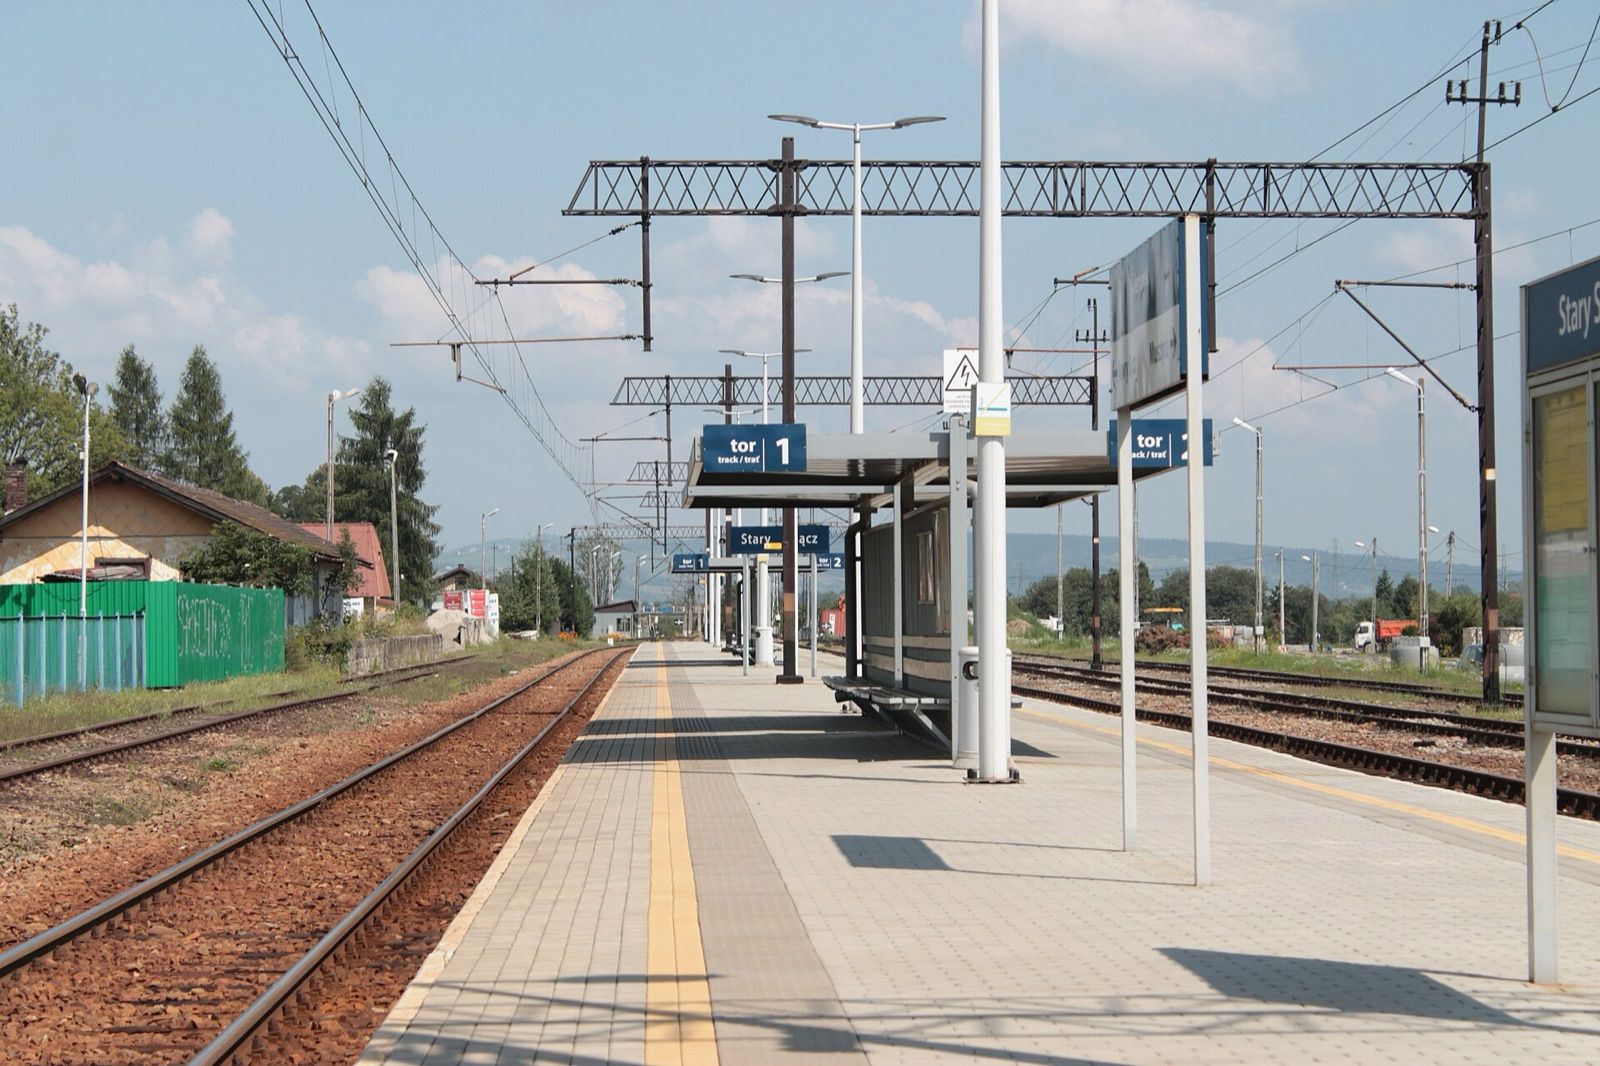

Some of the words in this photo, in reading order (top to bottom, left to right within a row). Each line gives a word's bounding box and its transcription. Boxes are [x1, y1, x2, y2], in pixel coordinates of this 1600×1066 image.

[1559, 294, 1592, 340] Stary
[1137, 434, 1163, 448] tor
[730, 439, 756, 452] tor
[776, 438, 789, 464] 1
[741, 533, 771, 544] Stary
[799, 535, 818, 546] ącz
[698, 558, 704, 569] 1
[833, 557, 842, 568] 2
